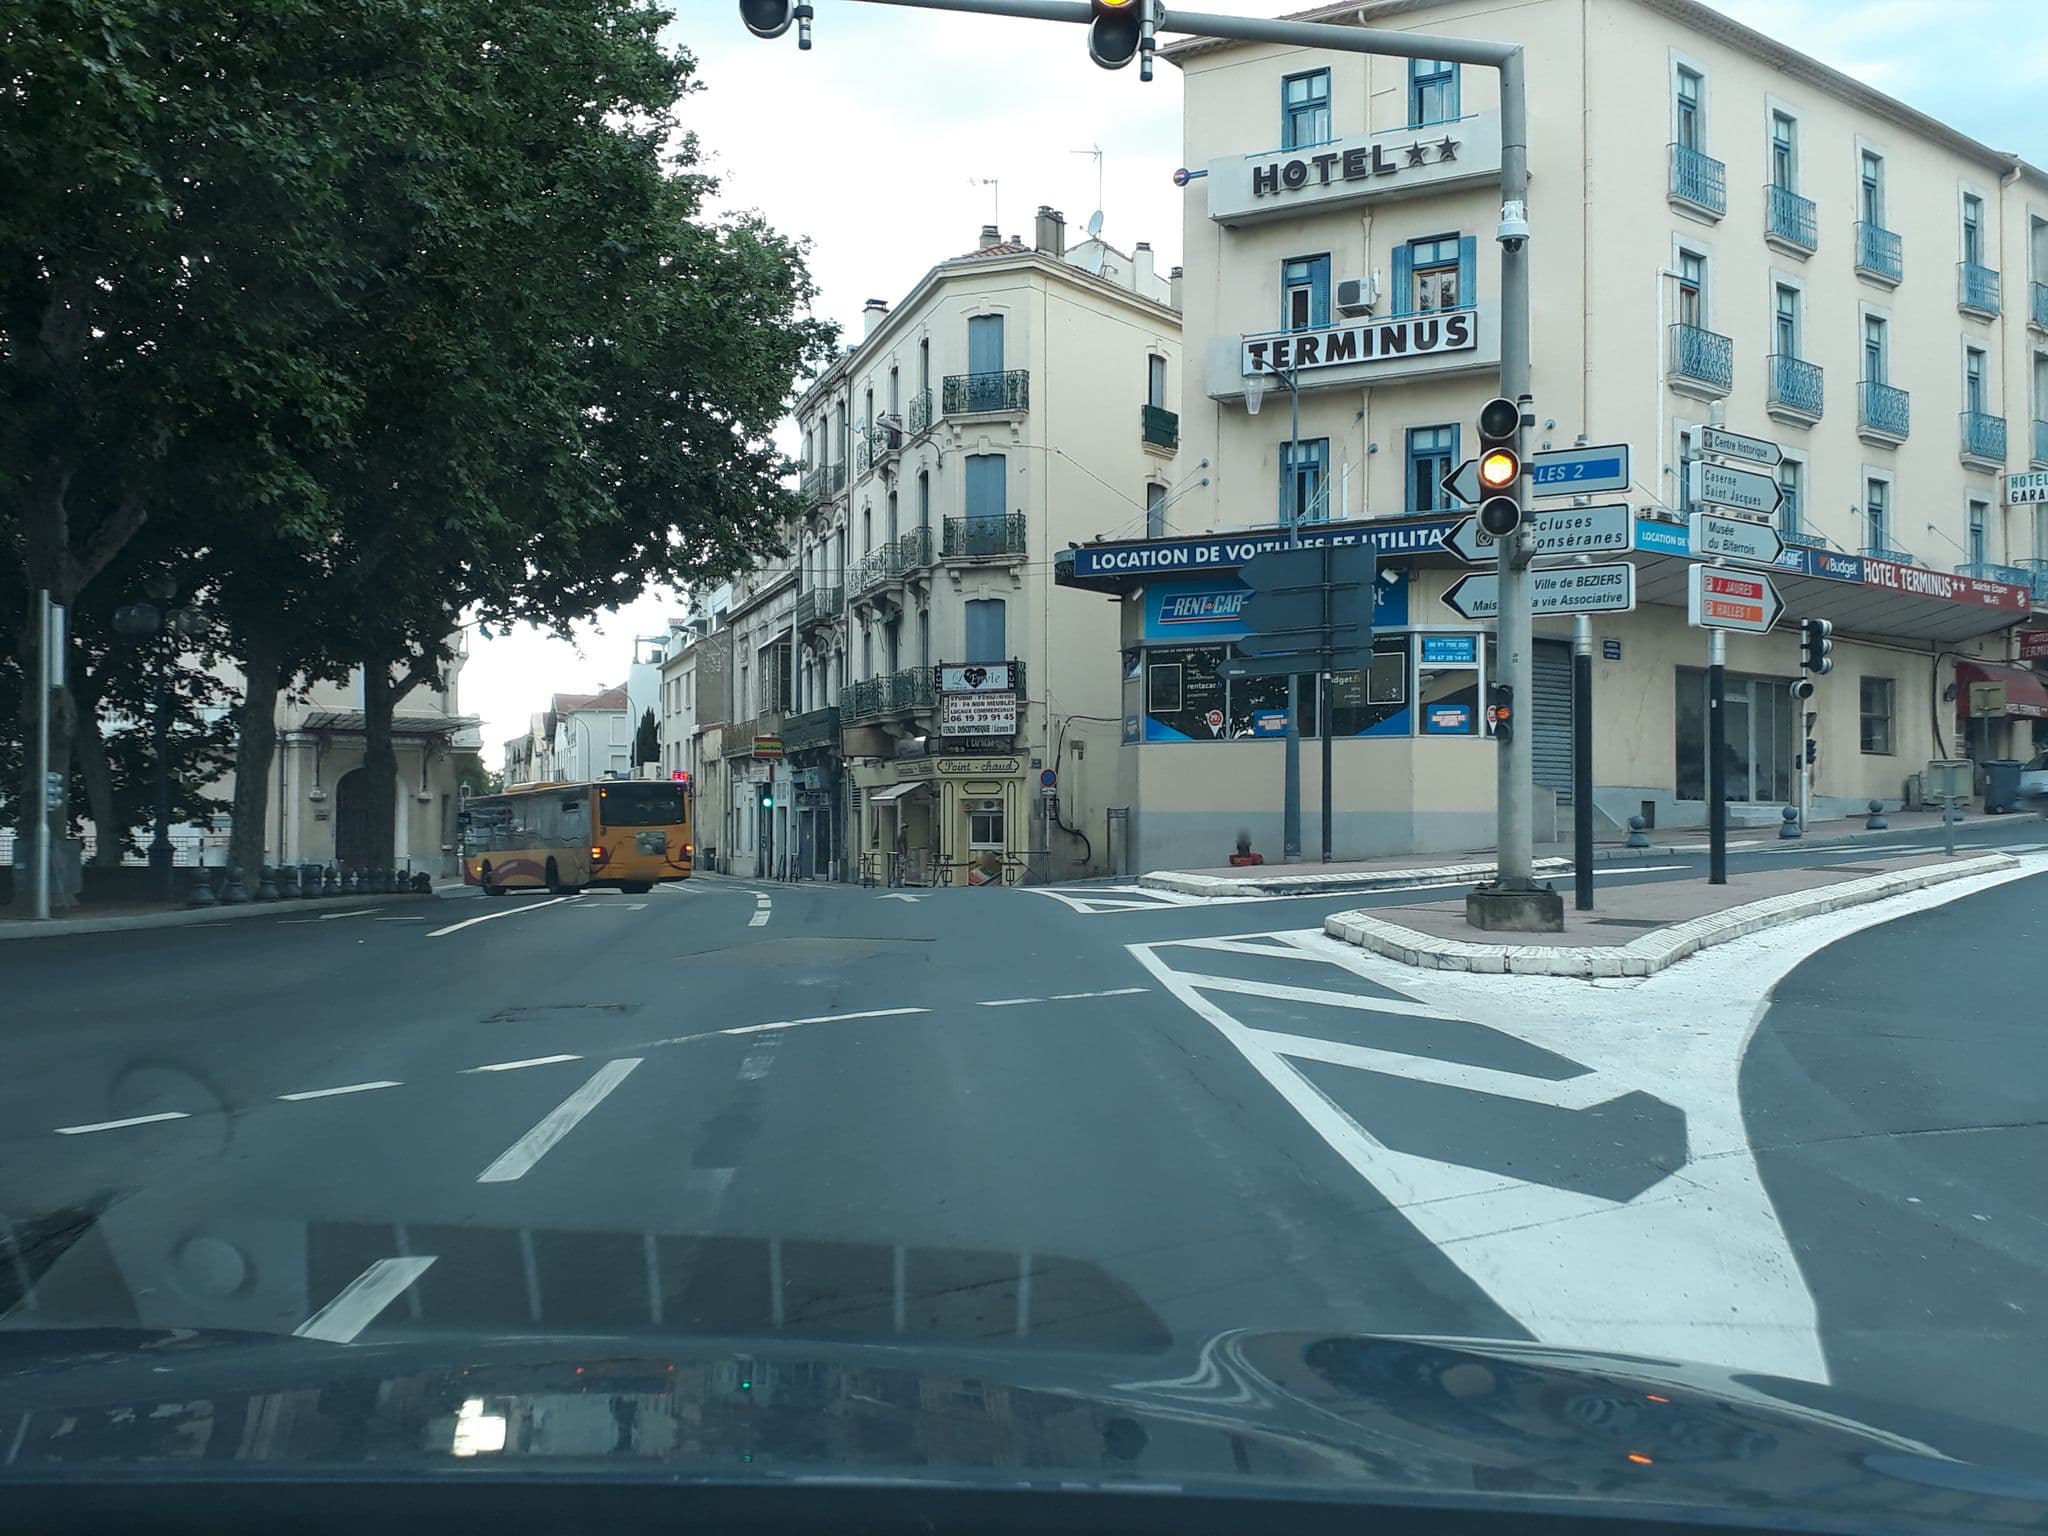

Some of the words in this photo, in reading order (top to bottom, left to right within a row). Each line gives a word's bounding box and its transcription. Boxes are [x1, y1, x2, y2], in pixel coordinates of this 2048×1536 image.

[1253, 144, 1398, 196] HOTEL
[1248, 315, 1468, 371] TERMINUS
[1714, 435, 1735, 451] Centre
[1736, 438, 1768, 459] historique
[1573, 464, 1584, 480] 2
[1704, 469, 1737, 486] Caserne
[2011, 473, 2048, 488] HOTEL
[1704, 484, 1727, 499] Saint
[1730, 491, 1762, 506] Jacques
[1708, 520, 1735, 536] Musée
[1532, 530, 1623, 549] onséranes
[1642, 531, 1677, 545] LOCATION
[1708, 538, 1720, 549] du
[1722, 539, 1756, 556] Biterrois
[1092, 548, 1188, 570] LOCATION
[1196, 546, 1220, 563] DE
[1830, 557, 1857, 578] Budget
[1535, 579, 1557, 590] Ville
[1560, 577, 1573, 588] de
[1576, 573, 1623, 587] BEZIERS
[1863, 559, 1899, 588] HOTEL
[1900, 568, 1952, 598] TERMINUS
[1173, 596, 1207, 616] RENT
[1213, 594, 1243, 614] CAR
[1542, 595, 1557, 607] vie
[1560, 592, 1623, 606] Associative
[950, 714, 962, 722] 06
[981, 760, 1013, 771] chaud
